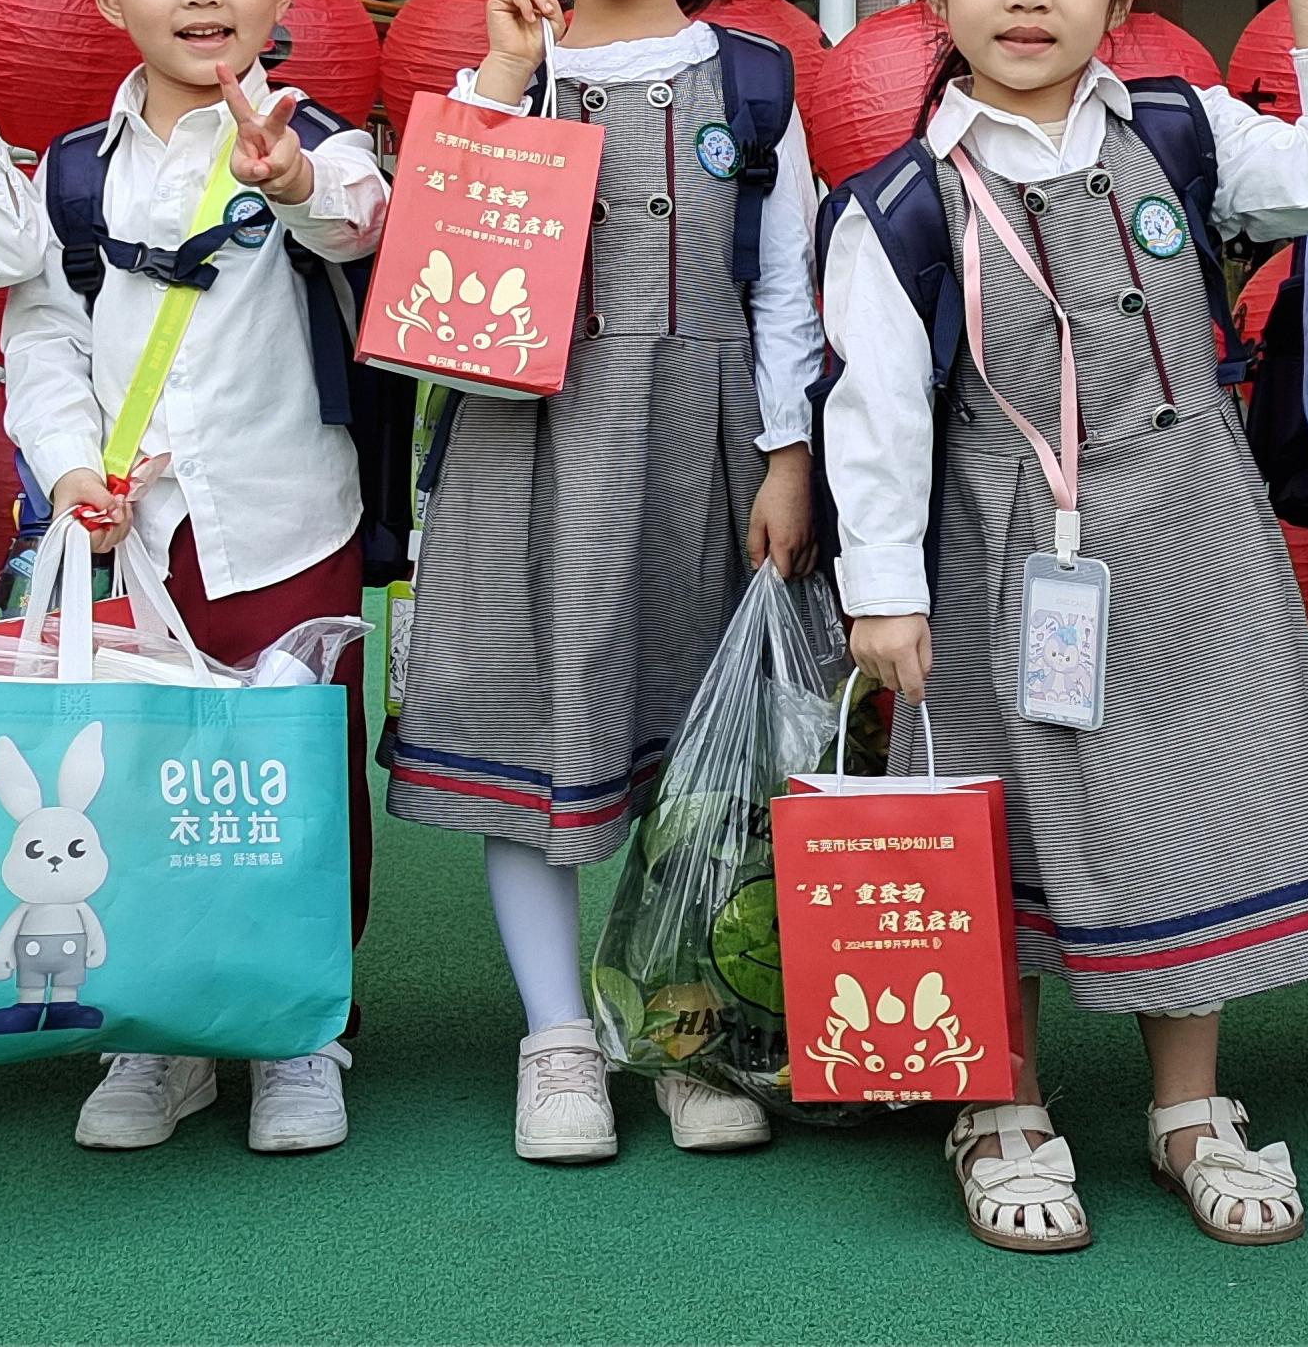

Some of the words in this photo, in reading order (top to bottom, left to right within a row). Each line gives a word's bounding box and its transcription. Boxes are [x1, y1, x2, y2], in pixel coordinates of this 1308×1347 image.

[435, 131, 566, 168] 东莞市长安镇乌沙幼儿园
[160, 759, 287, 806] elala
[169, 809, 281, 846] 衣拉拉
[806, 836, 955, 853] 东莞市长安镇乌沙幼儿园
[855, 882, 926, 905] 重登场
